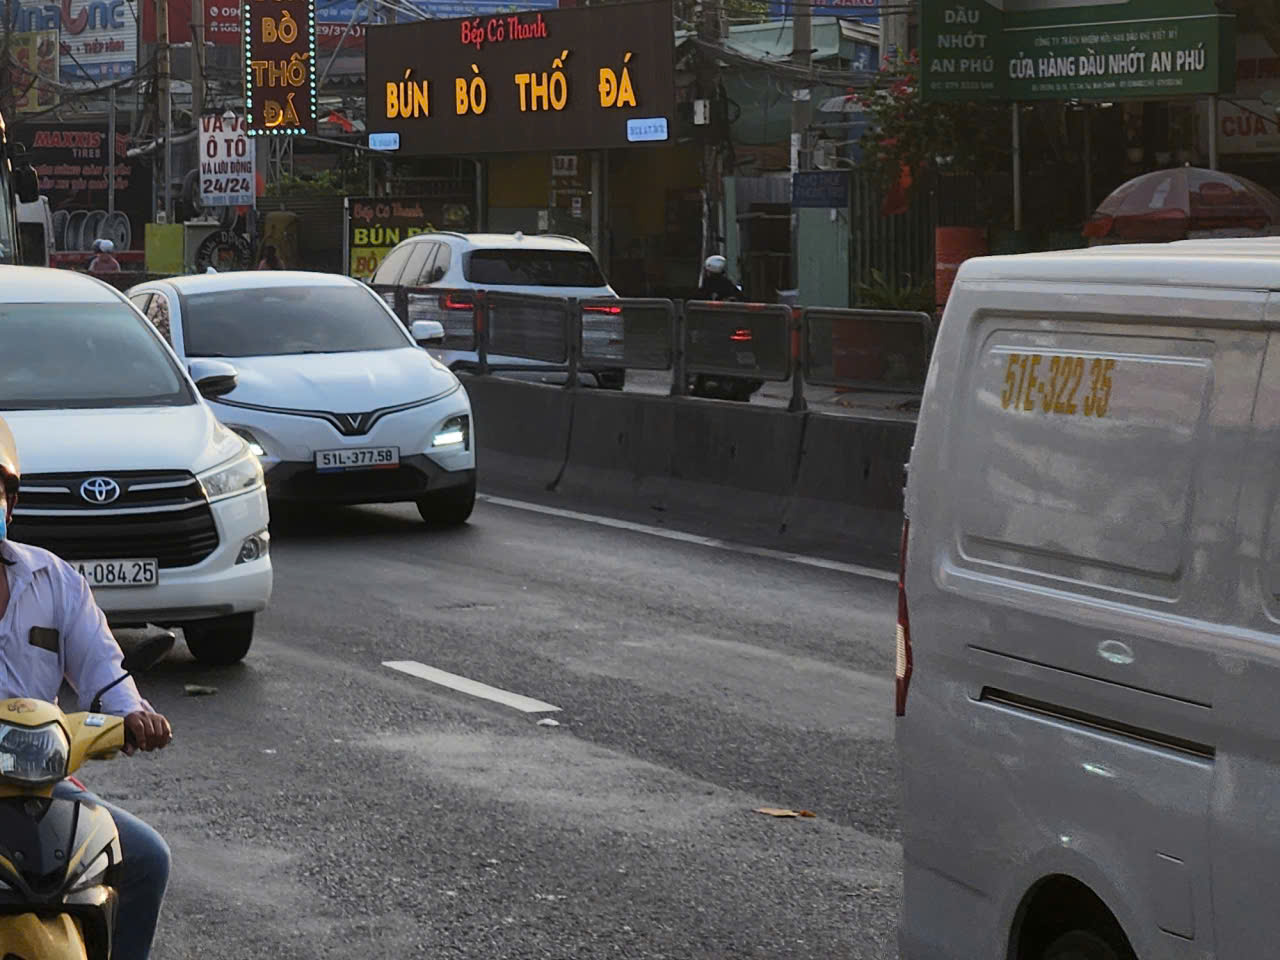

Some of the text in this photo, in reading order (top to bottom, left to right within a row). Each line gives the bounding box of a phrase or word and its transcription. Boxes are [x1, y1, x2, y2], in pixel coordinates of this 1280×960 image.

[944, 4, 980, 24] DẦU
[261, 9, 299, 44] BÒ
[461, 13, 548, 49] Bếp Cô Thanh
[937, 30, 988, 49] NHỚT
[930, 55, 995, 73] AN PHÚ
[1009, 43, 1205, 79] CỬA HÀNG DẦU NHỚT AN PHÚ
[386, 49, 637, 118] BÚN BÒ THỐ ĐÁ
[264, 91, 300, 127] ĐÁ
[33, 131, 102, 147] MAXXIS
[207, 134, 247, 158] Ô TÔ
[72, 149, 101, 158] TIRES
[230, 159, 253, 176] ĐỘNG
[203, 177, 251, 194] 24/24
[354, 224, 401, 246] BÚN
[322, 450, 393, 466] 51L-377.58
[72, 562, 154, 584] A-084.25
